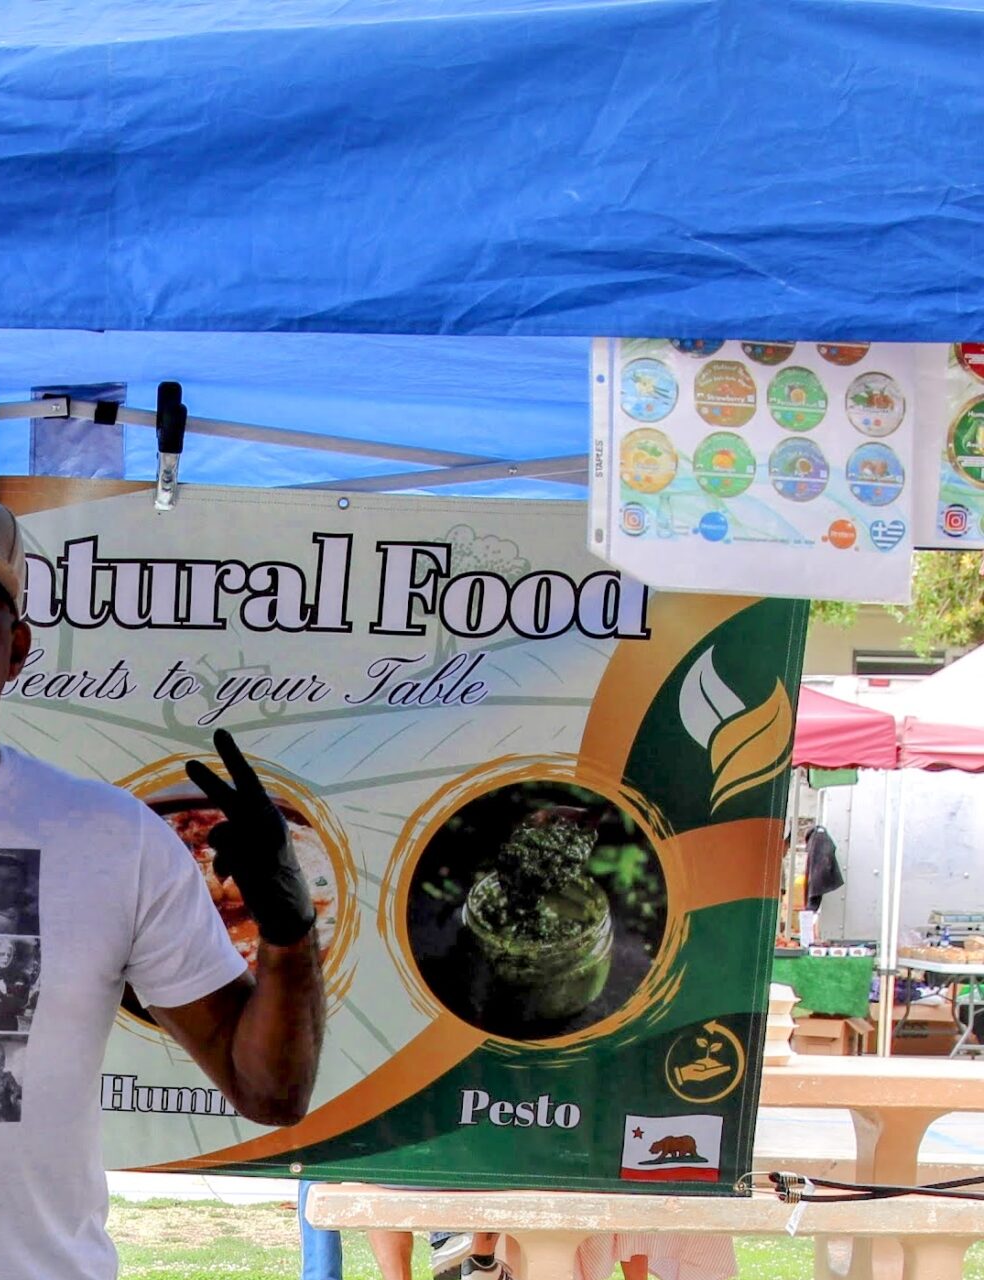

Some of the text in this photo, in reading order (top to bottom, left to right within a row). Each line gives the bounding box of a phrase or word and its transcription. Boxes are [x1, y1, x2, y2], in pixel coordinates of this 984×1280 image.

[595, 440, 604, 478] STAPLES
[21, 532, 353, 636] atural
[0, 648, 137, 700] earts
[153, 657, 199, 702] to
[197, 668, 330, 726] your
[346, 651, 488, 707] Table
[459, 1088, 582, 1131] Pesto
